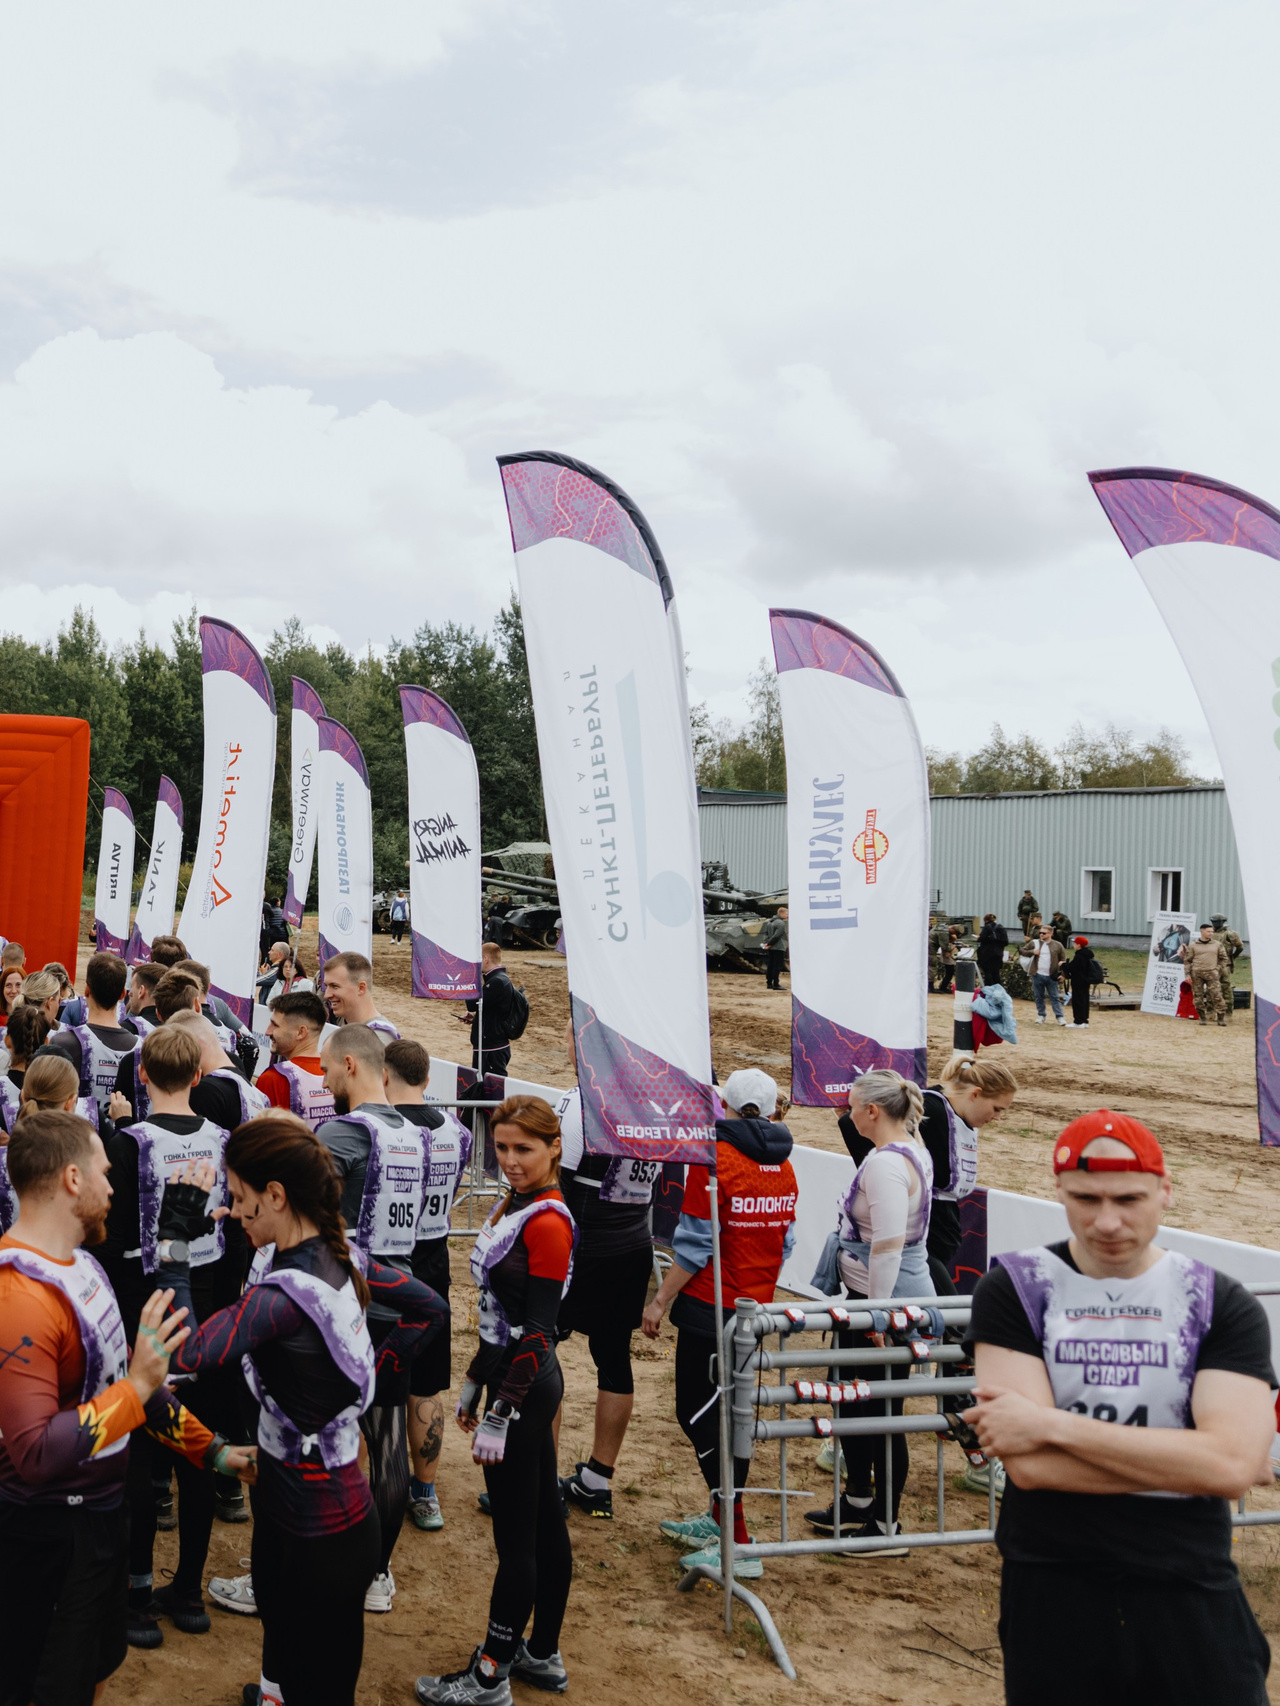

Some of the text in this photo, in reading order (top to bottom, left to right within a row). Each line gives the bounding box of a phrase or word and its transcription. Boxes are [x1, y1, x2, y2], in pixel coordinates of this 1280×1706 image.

[164, 1150, 213, 1162] ГОНКА ГЕРОЕВ
[430, 1163, 456, 1175] СОВЫЙ
[629, 1160, 657, 1183] 953
[388, 1202, 414, 1228] 905
[190, 1249, 214, 1259] ПРОМБАНК
[1066, 1305, 1162, 1317] ГОНКА ГЕРОЕВ
[1059, 1341, 1163, 1365] МАССОВЫЙ
[1086, 1364, 1138, 1386] СТАРТ
